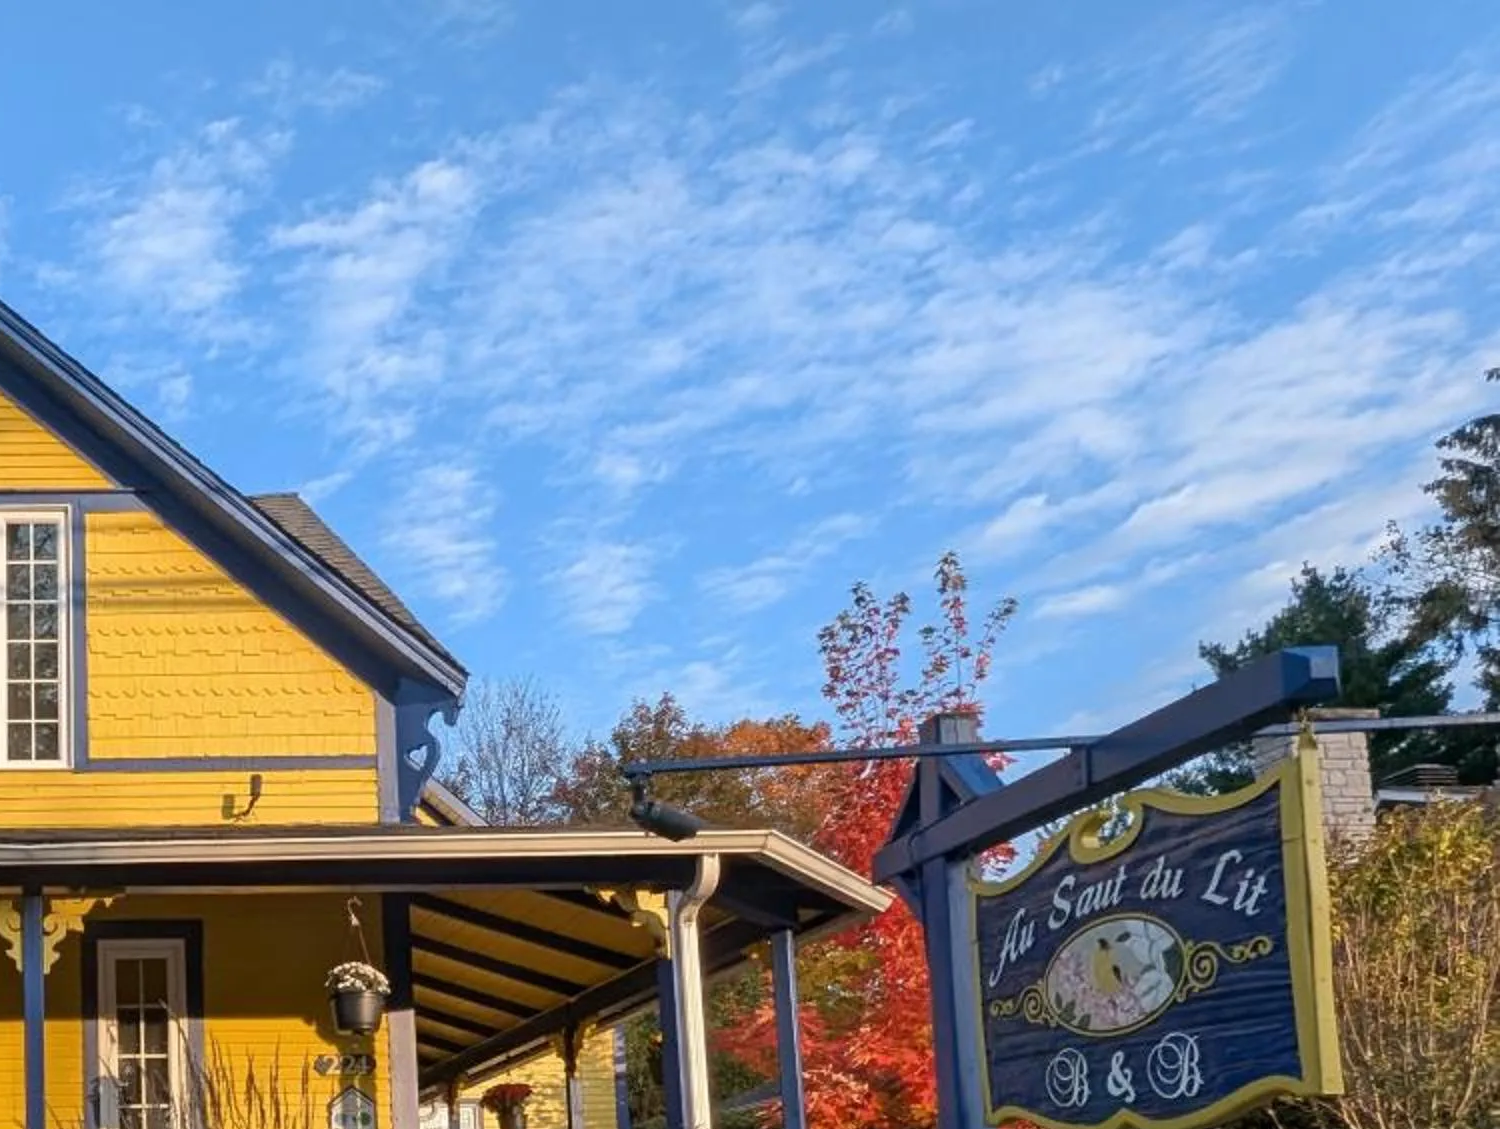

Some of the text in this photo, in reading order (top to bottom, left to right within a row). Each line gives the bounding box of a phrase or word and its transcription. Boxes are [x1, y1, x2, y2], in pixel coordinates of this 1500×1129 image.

[988, 848, 1269, 988] Au Saut du Lit
[323, 1055, 371, 1074] 224
[1045, 1031, 1206, 1107] B & B
